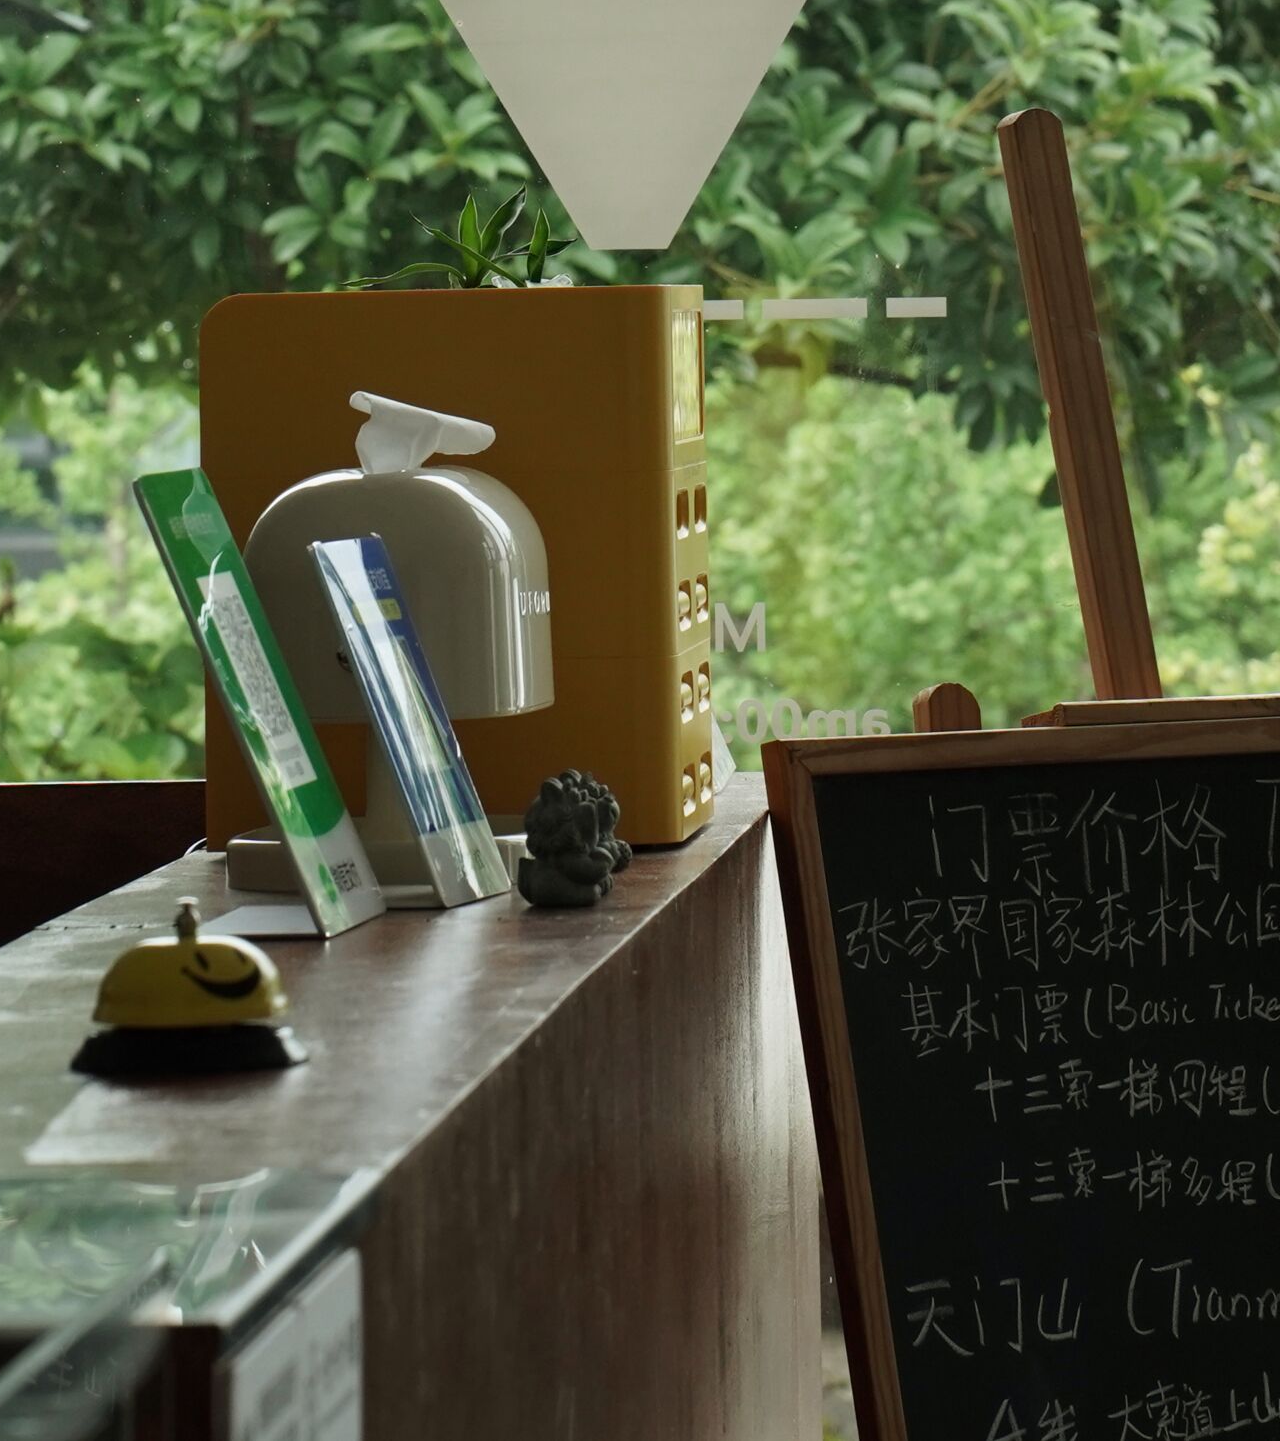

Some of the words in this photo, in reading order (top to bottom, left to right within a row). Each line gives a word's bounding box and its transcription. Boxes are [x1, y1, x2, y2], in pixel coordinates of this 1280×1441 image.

[928, 778, 1228, 896] 门票价格
[900, 981, 1069, 1058] 基本门票
[1083, 983, 1196, 1040] (Basic
[904, 1275, 1083, 1358] 天门山
